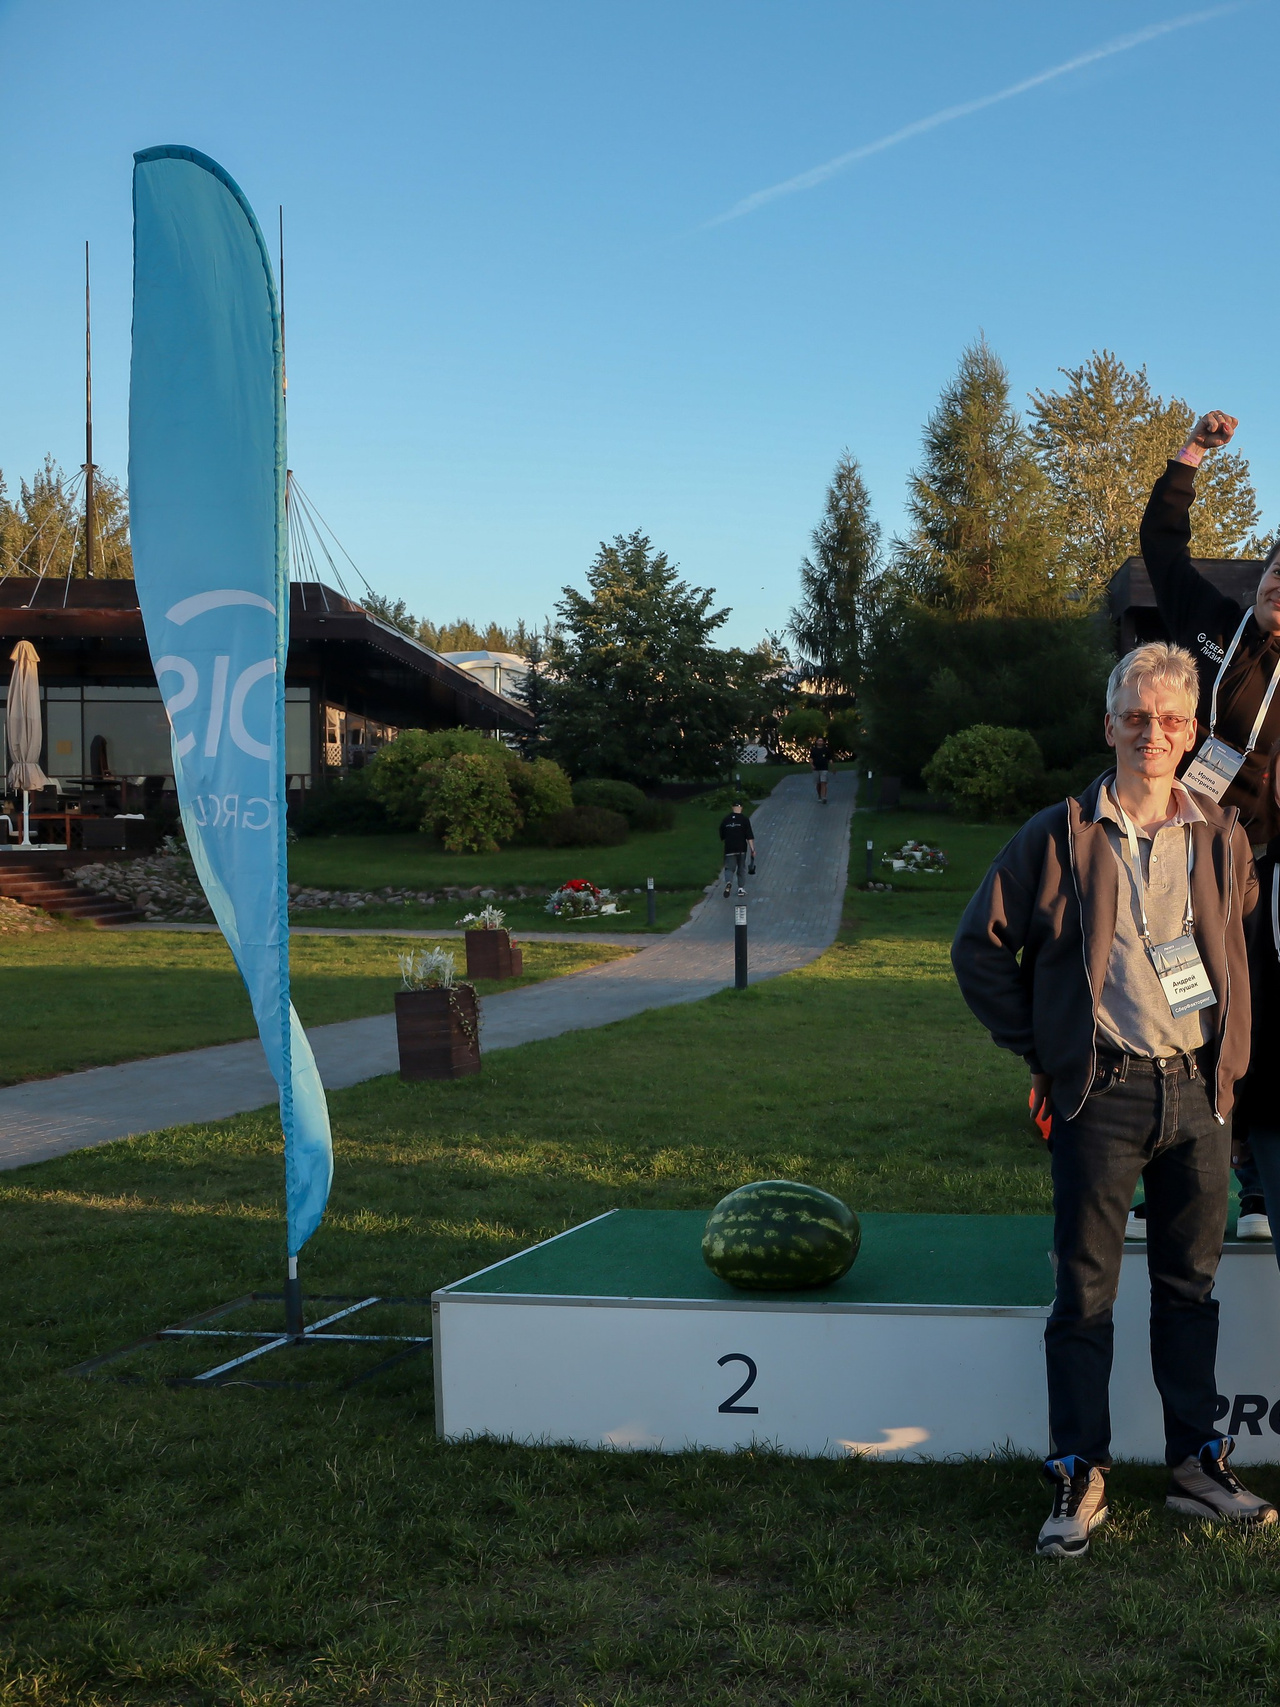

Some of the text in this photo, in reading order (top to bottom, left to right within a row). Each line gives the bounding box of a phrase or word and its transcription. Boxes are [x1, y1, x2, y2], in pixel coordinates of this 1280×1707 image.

[1205, 639, 1225, 655] СБЕР
[1200, 646, 1231, 667] ЛИЗИН
[1187, 772, 1220, 796] Вострикова
[1198, 770, 1216, 785] Ирина
[1172, 974, 1196, 988] Андрей
[1174, 982, 1199, 995] Глушак
[716, 1352, 760, 1415] 2
